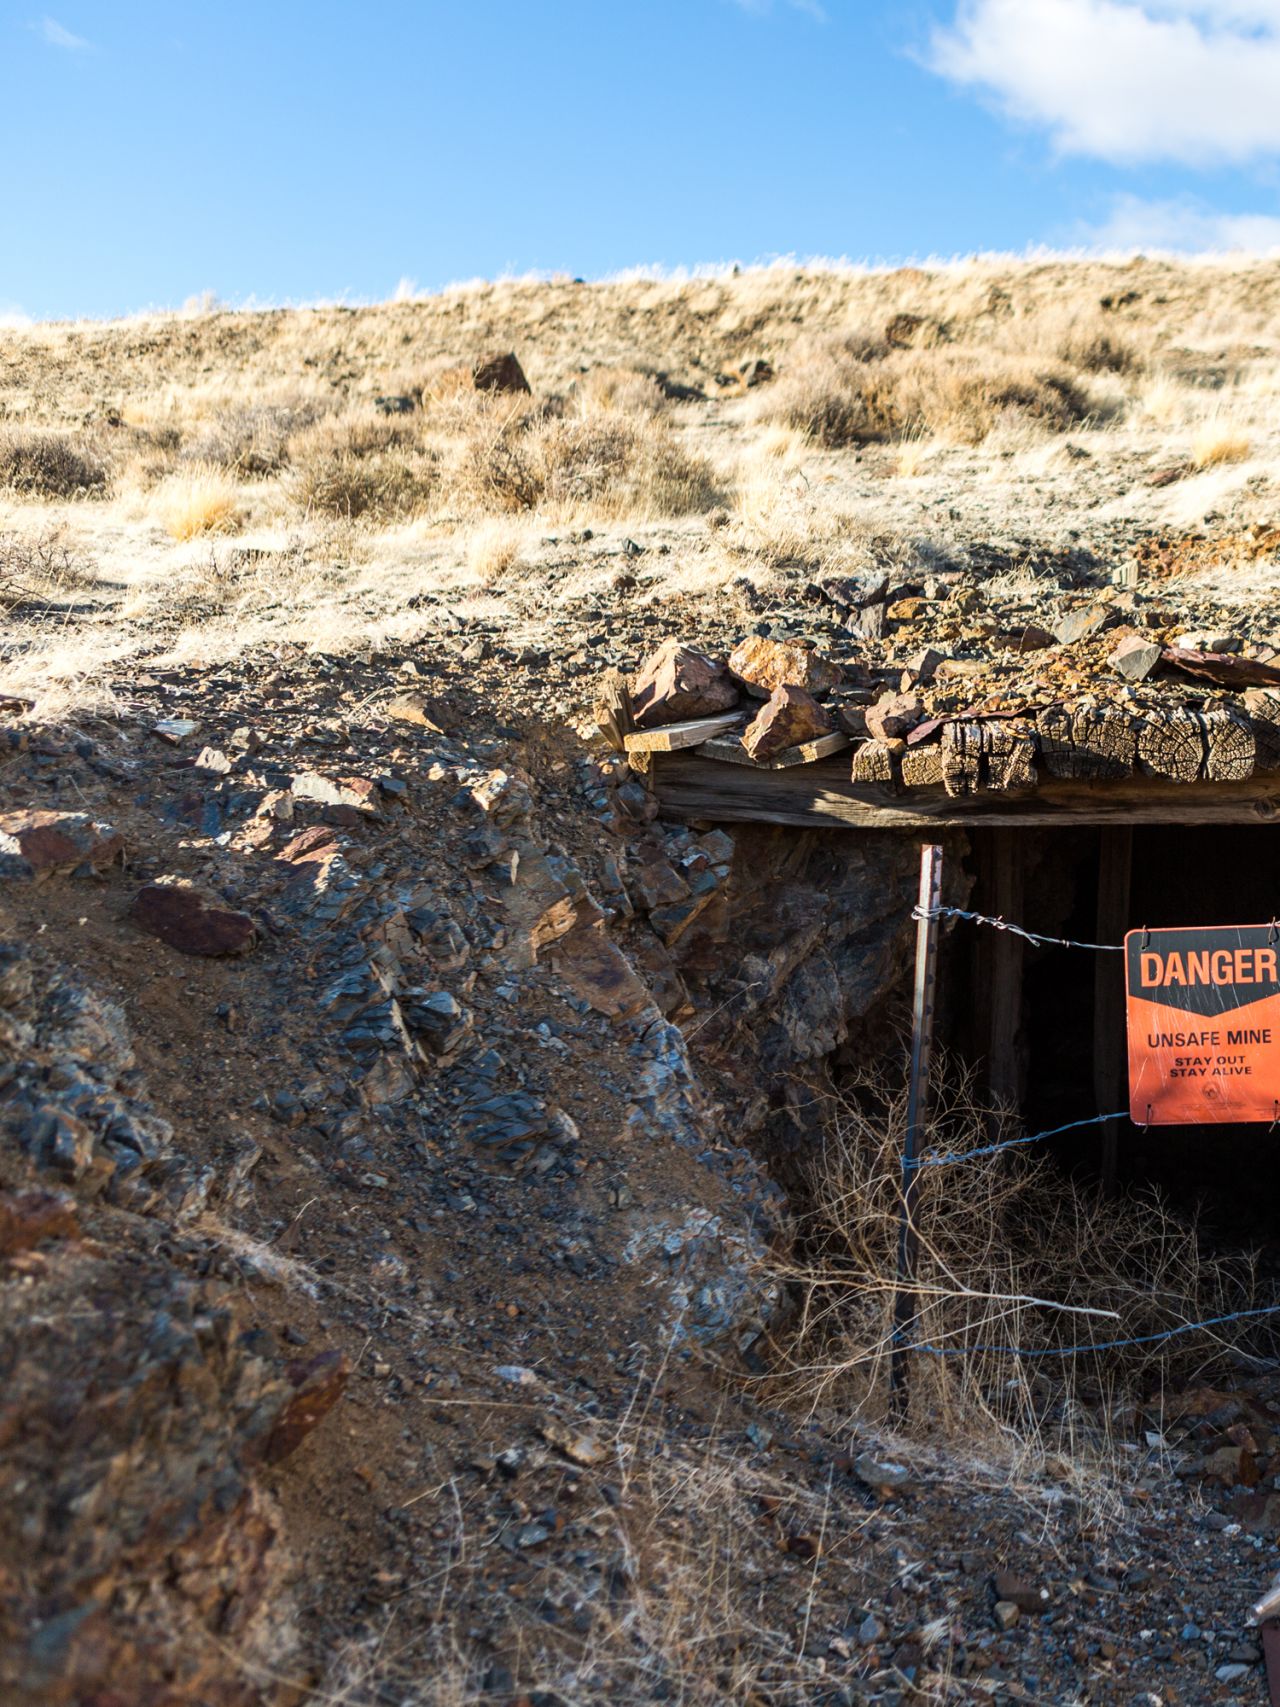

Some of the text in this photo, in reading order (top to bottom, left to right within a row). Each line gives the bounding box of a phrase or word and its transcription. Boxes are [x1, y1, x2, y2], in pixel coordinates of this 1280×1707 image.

[1140, 948, 1278, 987] DANGER
[1148, 1029, 1272, 1048] UNSAFE MINE
[1175, 1055, 1246, 1066] STAY OUT
[1170, 1066, 1252, 1078] STAY ALIVE
